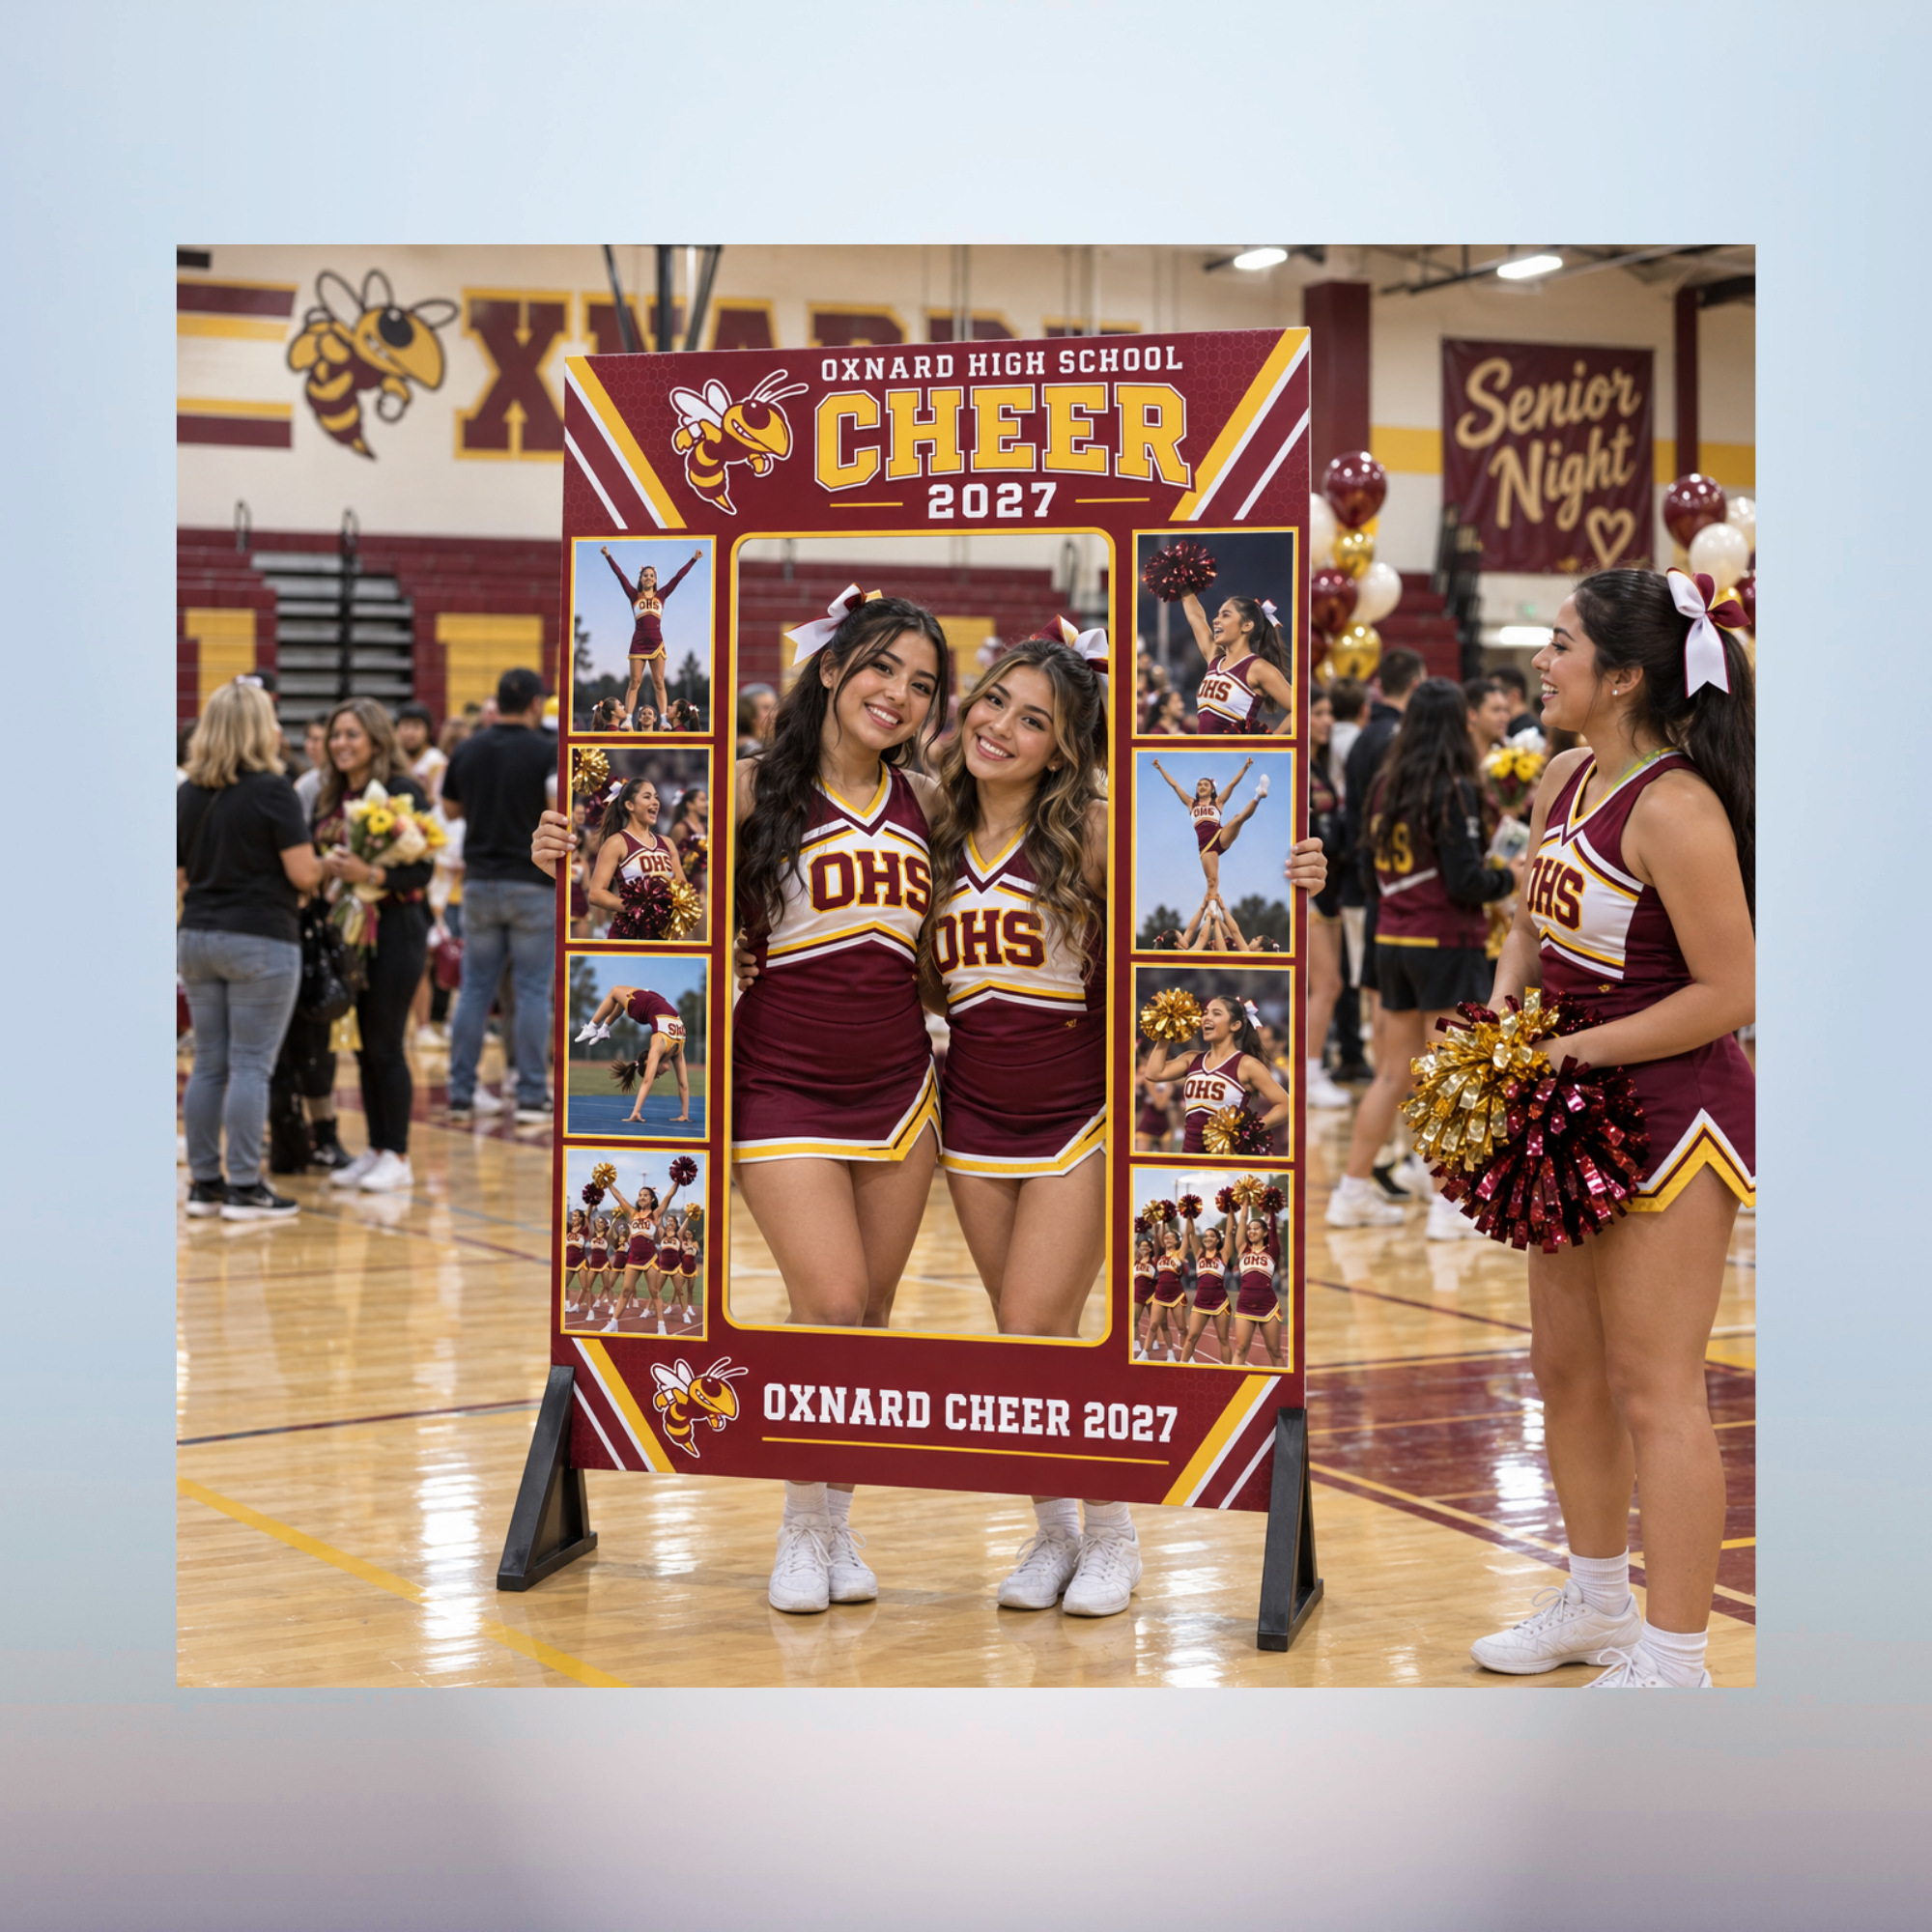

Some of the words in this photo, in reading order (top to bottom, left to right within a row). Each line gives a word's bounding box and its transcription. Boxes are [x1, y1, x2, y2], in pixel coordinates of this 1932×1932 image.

[822, 355, 954, 382] OXNARD
[968, 351, 1045, 377] HIGH
[1059, 346, 1183, 374] SCHOOL
[814, 382, 1191, 492] CHEER
[1455, 356, 1641, 450] Senior
[927, 482, 1057, 520] 2027
[1489, 423, 1636, 530] Night
[809, 848, 932, 918] OHS
[930, 907, 1047, 977] OHS
[1183, 1079, 1226, 1101] OHS
[763, 1383, 930, 1429] OXNARD
[945, 1393, 1070, 1436] CHEER
[1084, 1402, 1178, 1443] 2027
